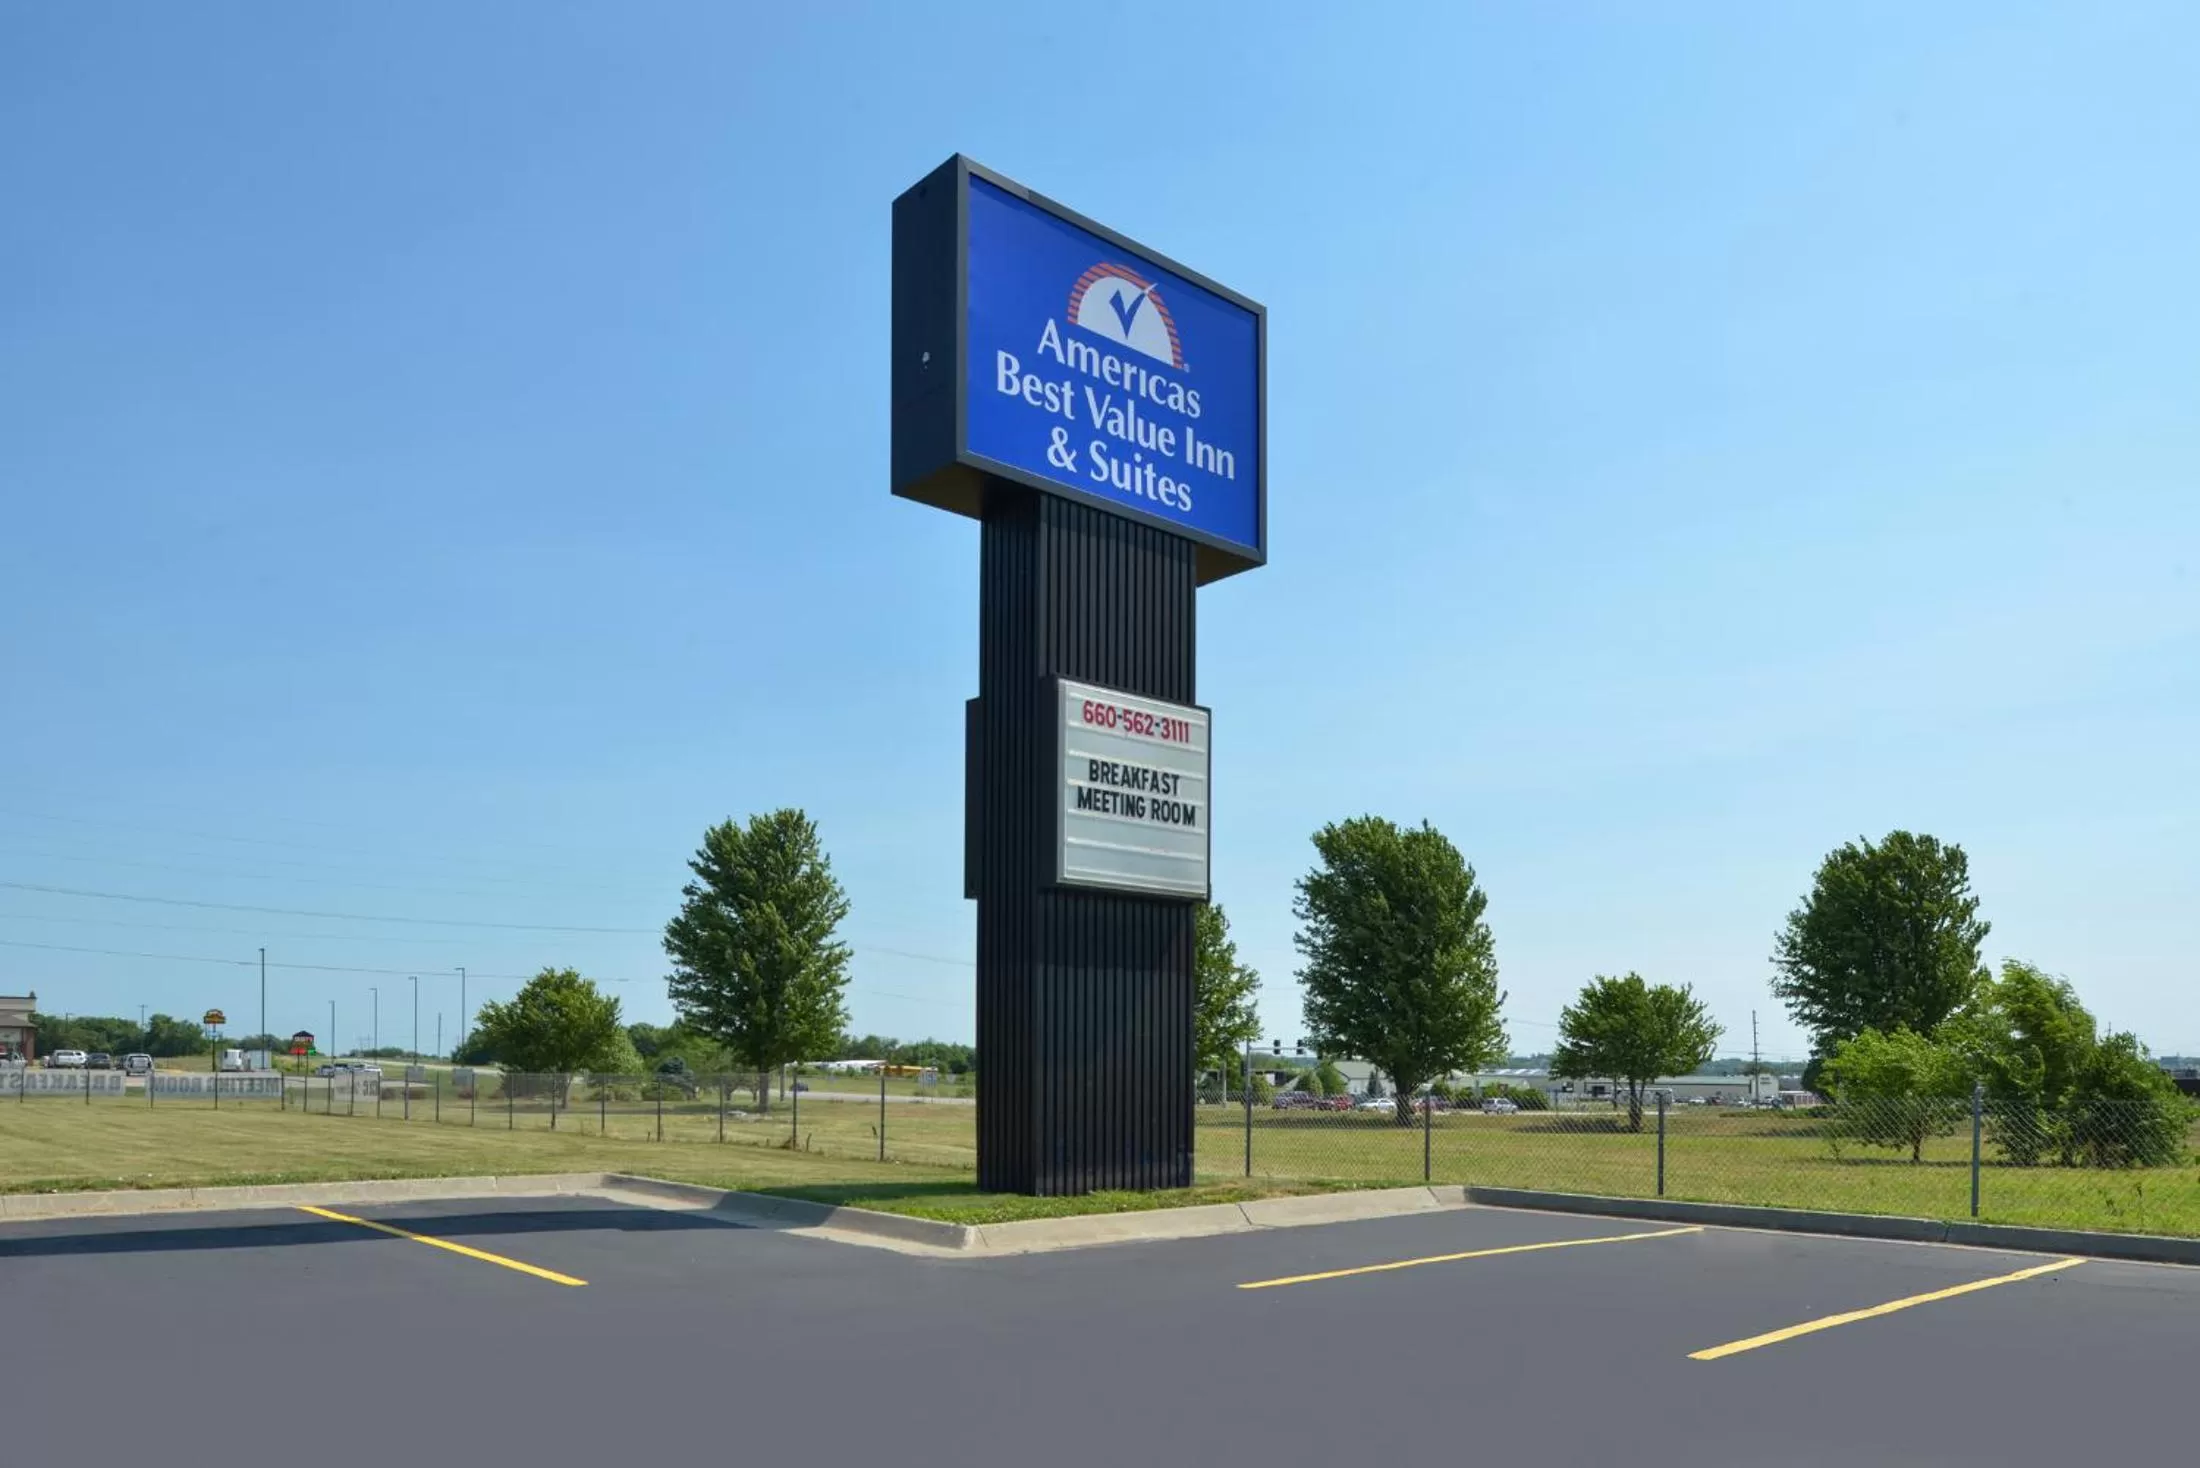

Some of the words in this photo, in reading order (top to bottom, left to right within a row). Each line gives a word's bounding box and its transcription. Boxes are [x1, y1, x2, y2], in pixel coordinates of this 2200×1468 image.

[1037, 318, 1201, 418] Americas
[996, 350, 1075, 420] Best
[1085, 385, 1176, 457] Value
[1186, 427, 1235, 480] Inn
[1047, 426, 1077, 473] &
[1089, 440, 1192, 512] Suites
[1083, 700, 1190, 744] 660-562-3111
[1077, 786, 1147, 819] MEETING
[1151, 799, 1196, 827] ROOM
[1089, 759, 1180, 796] BREAKFAST
